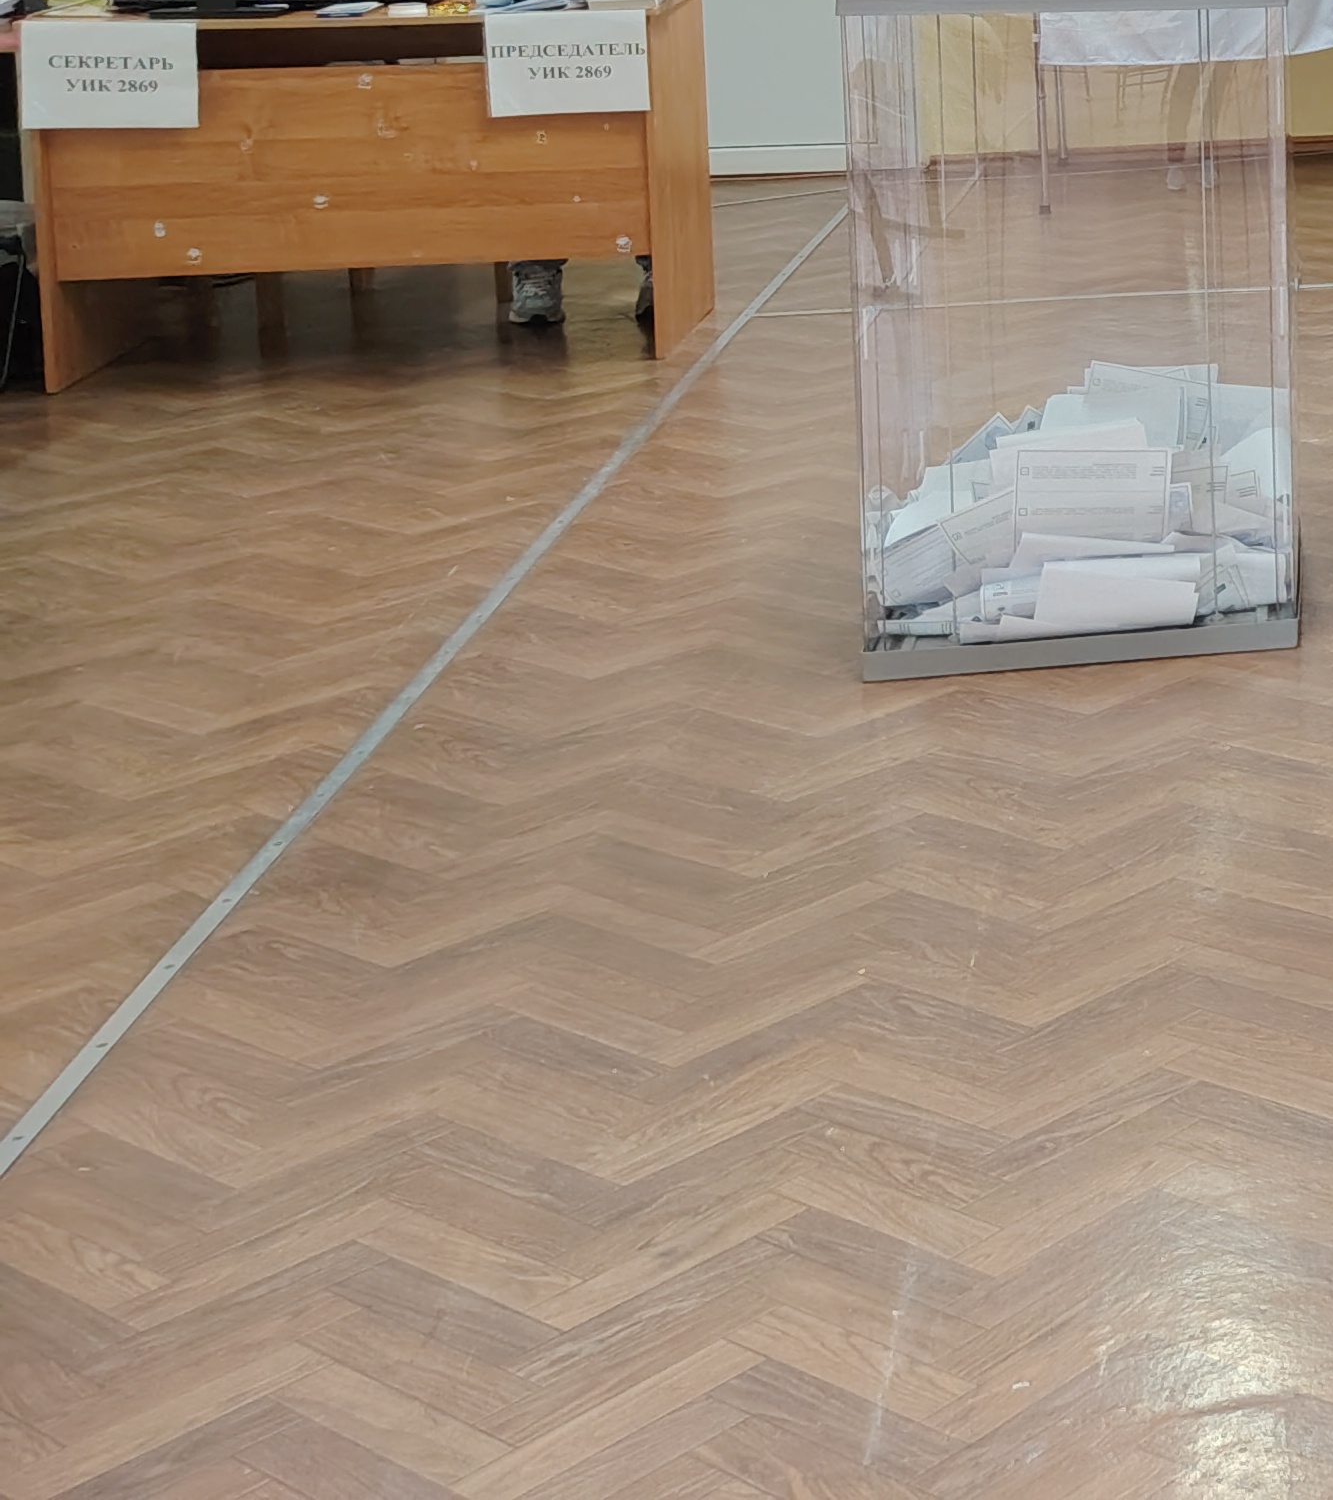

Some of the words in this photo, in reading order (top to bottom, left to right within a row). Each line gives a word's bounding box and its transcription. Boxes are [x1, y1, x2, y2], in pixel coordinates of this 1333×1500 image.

[490, 42, 646, 60] ПРЕДСЕДАТЕЛЬ
[48, 54, 174, 71] СЕКРЕТАРЬ
[527, 66, 571, 80] УИК
[575, 65, 612, 79] 2869
[65, 78, 112, 93] УИК
[117, 79, 159, 93] 2869
